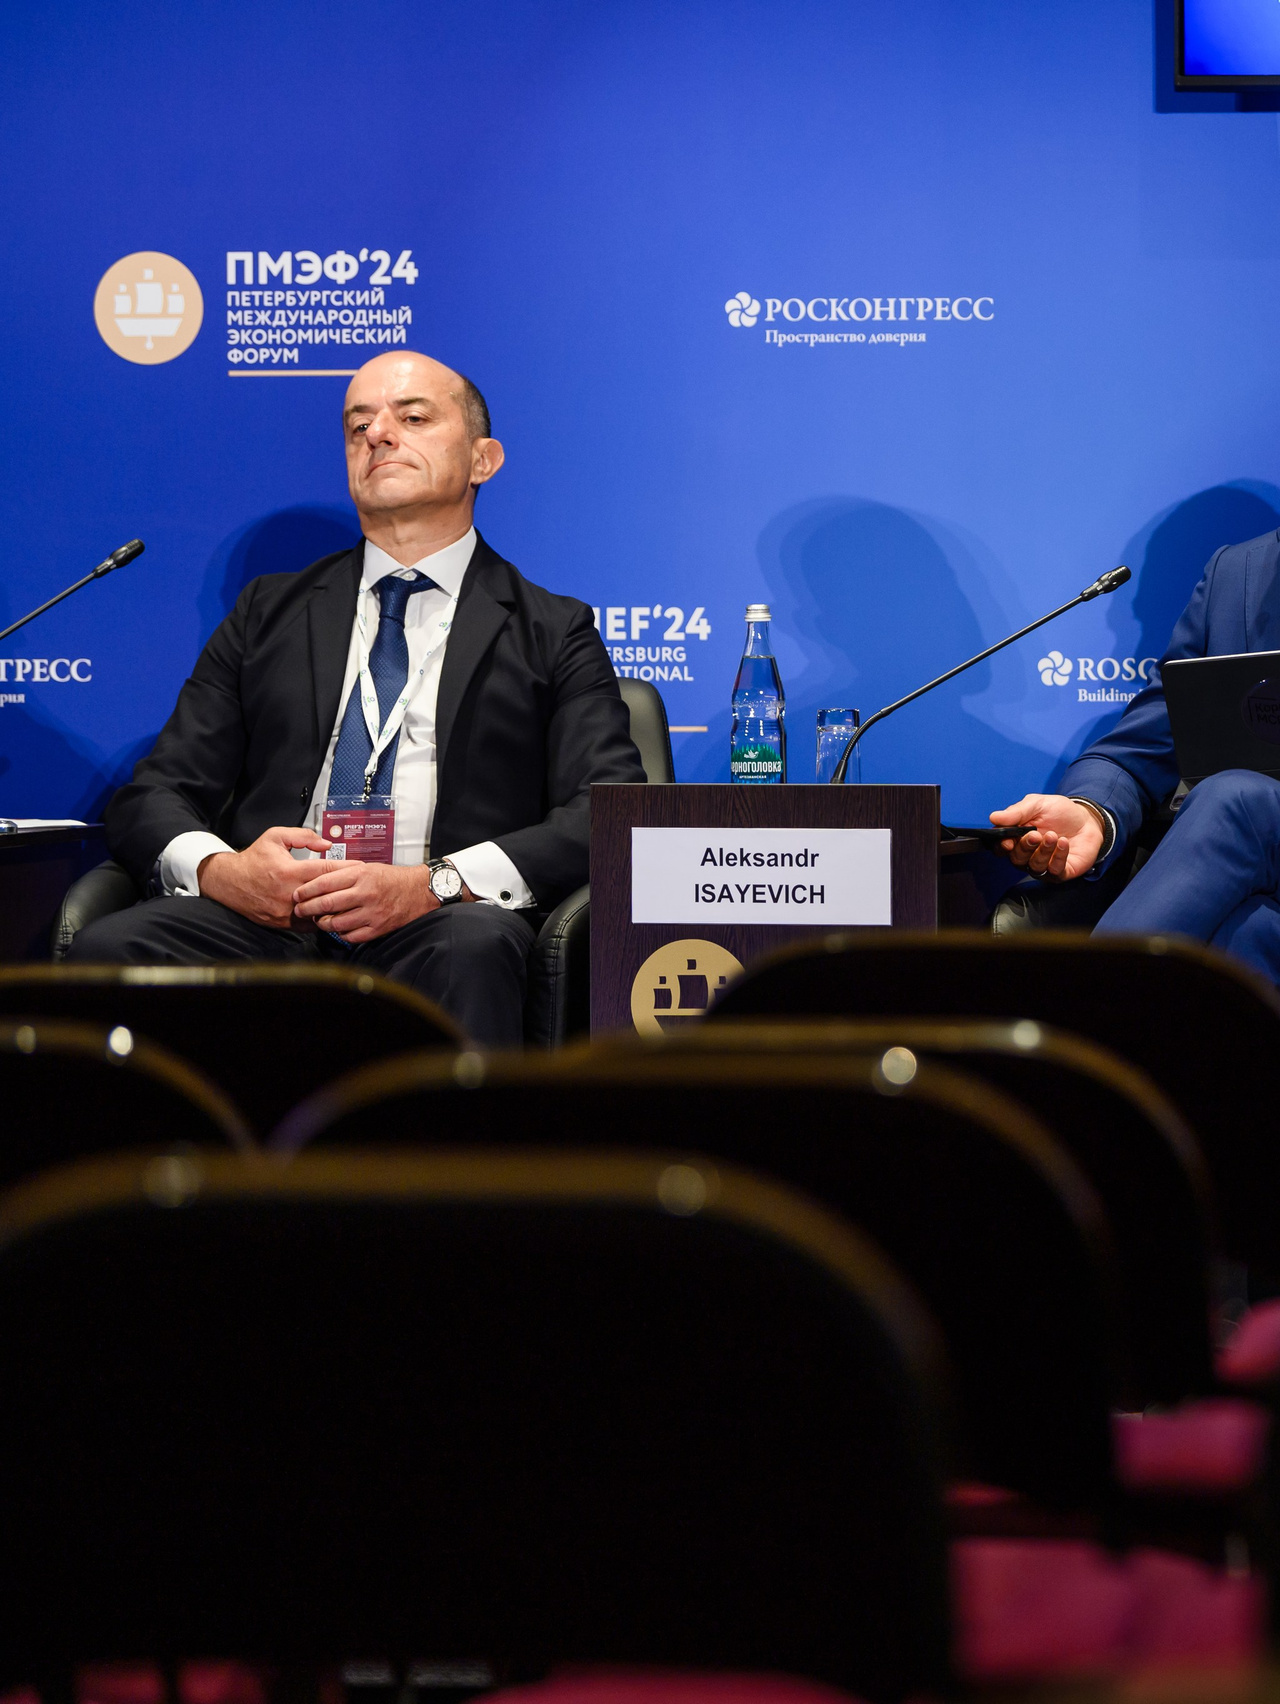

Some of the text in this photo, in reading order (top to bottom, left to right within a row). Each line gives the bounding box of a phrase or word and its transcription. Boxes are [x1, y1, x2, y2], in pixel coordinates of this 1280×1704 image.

[226, 286, 385, 307] ПЕТЕРБУРГСКИЙ
[226, 306, 412, 329] МЕЖДУНАРОДНЫЙ
[764, 296, 995, 322] РОСКОНГРЕСС
[226, 325, 407, 345] ЭКОНОМИЧЕСКИЙ
[765, 329, 926, 347] Пространство доверия
[226, 348, 299, 364] ФОРУМ
[592, 603, 712, 641] IEF‘24
[0, 658, 92, 683] ГРЕСС
[1077, 657, 1157, 681] ROSC
[731, 761, 782, 775] ерноголовка
[700, 847, 820, 867] Aleksandr
[694, 883, 825, 904] ISAYEVICH
